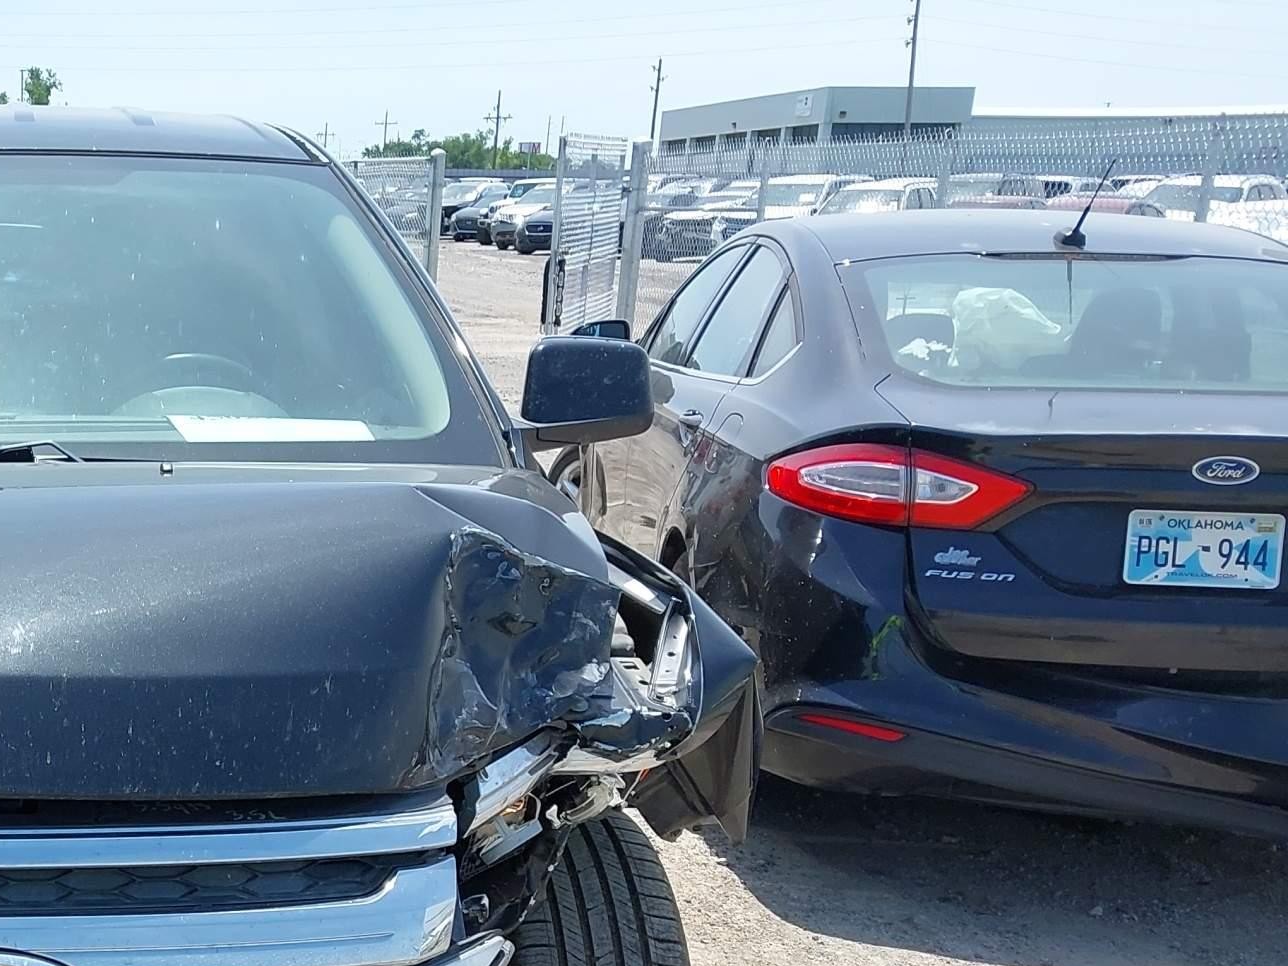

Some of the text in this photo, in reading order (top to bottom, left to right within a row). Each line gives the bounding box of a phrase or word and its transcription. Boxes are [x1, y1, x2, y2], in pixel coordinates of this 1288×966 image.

[1206, 460, 1247, 478] Ford
[1167, 518, 1245, 531] OKLAHOMA
[1135, 535, 1269, 572] PGL 944
